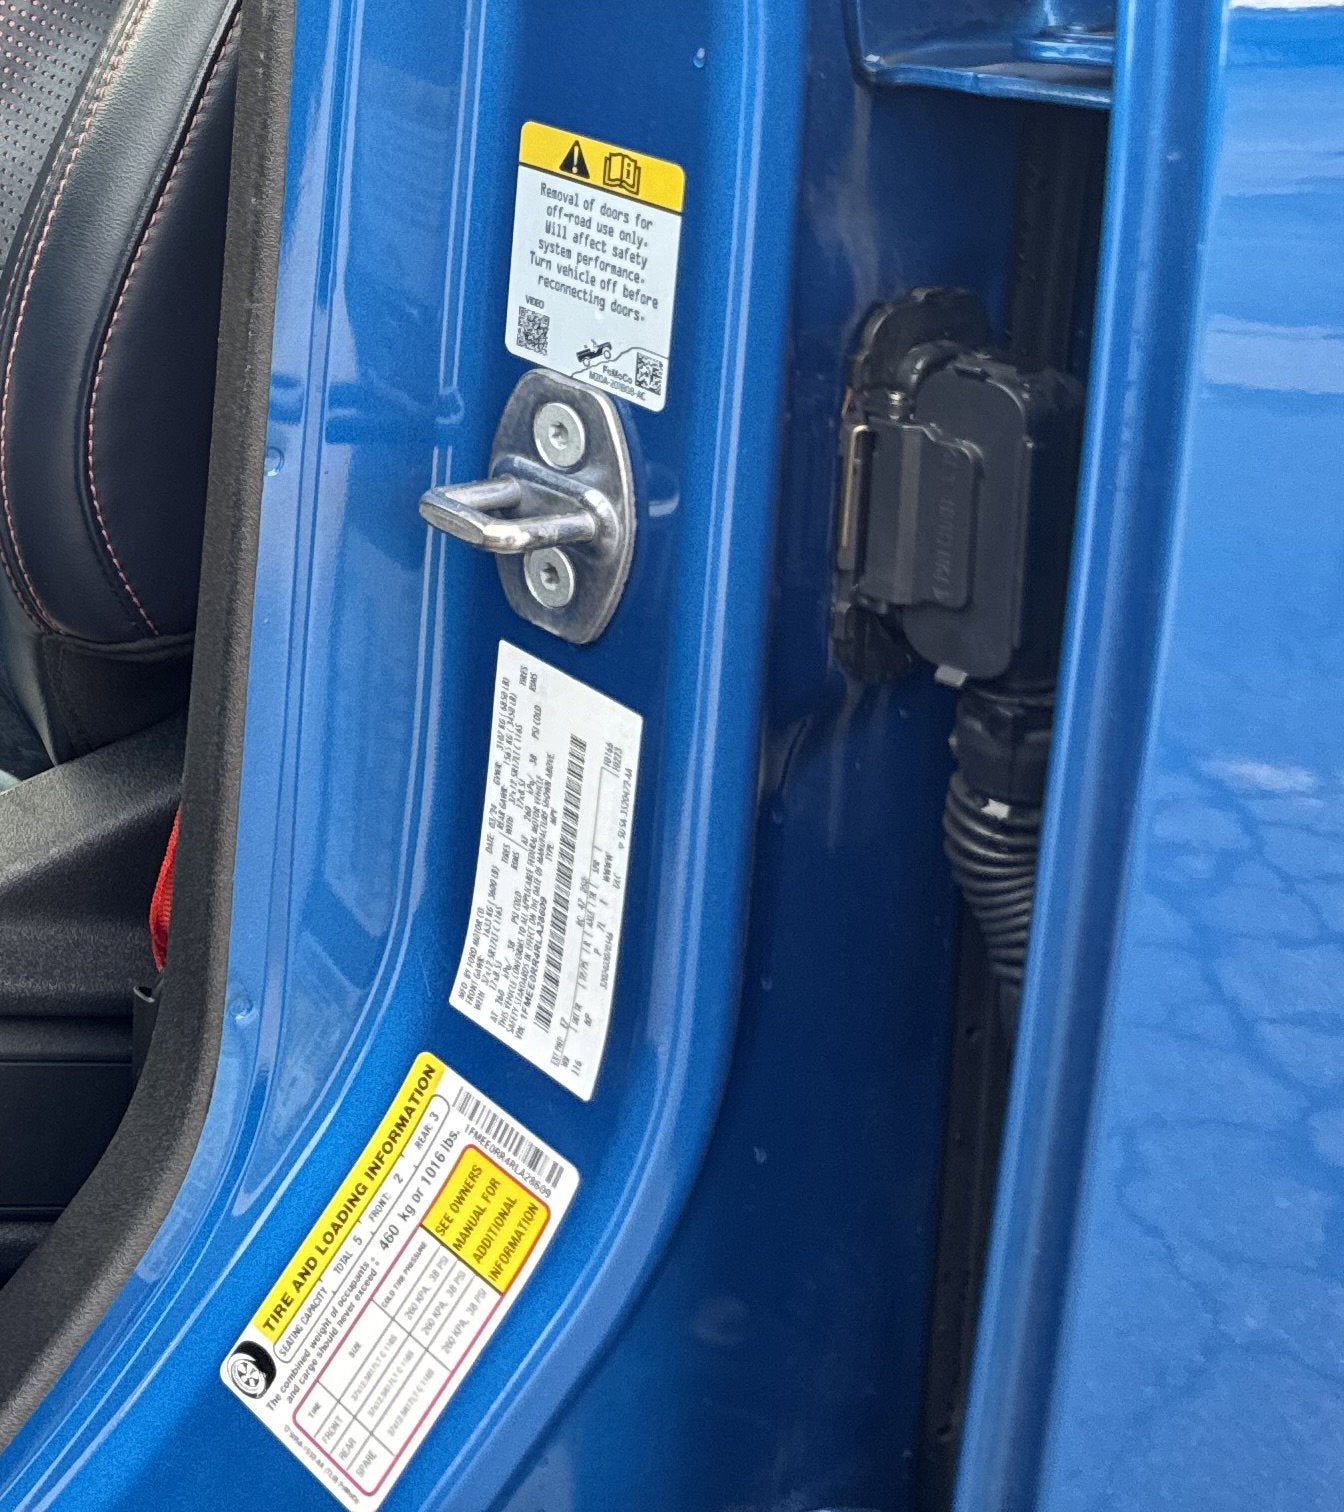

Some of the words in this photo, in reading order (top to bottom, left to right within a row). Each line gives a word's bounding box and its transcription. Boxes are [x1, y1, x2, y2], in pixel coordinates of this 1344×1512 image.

[540, 181, 579, 207] Removal
[583, 196, 594, 212] of
[600, 202, 629, 223] doors
[635, 213, 653, 232] for
[546, 202, 592, 230] off-road
[596, 220, 614, 237] use
[619, 227, 648, 251] only.
[529, 250, 551, 270] Turn
[556, 260, 596, 287] vehicle
[599, 276, 617, 294] off
[622, 284, 658, 309] before
[538, 236, 572, 263] system
[576, 250, 645, 289] performance.
[544, 220, 567, 240] Will
[572, 229, 607, 254] affect
[611, 243, 648, 270] safety
[537, 271, 605, 311] reconnecting
[610, 299, 645, 324] doors.
[262, 1289, 295, 1336] TIRE
[289, 1253, 319, 1294] AND
[314, 1178, 368, 1257] LOADING
[359, 1062, 441, 1182] INFORMATION
[377, 1222, 400, 1251] 460
[397, 1201, 416, 1223] kg
[411, 1186, 425, 1204] or
[419, 1150, 446, 1186] 1016
[439, 1125, 461, 1152] lbs.
[434, 1211, 454, 1237] SEE
[447, 1163, 484, 1214] OWNERS
[451, 1201, 487, 1251] MANUAL
[480, 1176, 501, 1203] FOR
[278, 1321, 304, 1358] SEATING
[299, 1284, 328, 1326] CAPACITY
[352, 1233, 363, 1246] 5
[392, 1172, 404, 1184] 2
[428, 1110, 439, 1122] 3
[403, 1240, 427, 1276] PRESSURE
[469, 1193, 519, 1264] ADDITIONAL
[485, 1201, 542, 1283] INFORMATION
[445, 1283, 458, 1298] 38
[453, 1269, 466, 1285] PSI
[465, 1300, 478, 1316] 38
[473, 1286, 487, 1303] PSI
[265, 1390, 281, 1412] The
[279, 1348, 311, 1395] combined
[308, 1316, 332, 1351] weight
[328, 1305, 339, 1318] of
[336, 1259, 370, 1309] occupants
[285, 1383, 300, 1404] and
[298, 1357, 319, 1387] cargo
[315, 1325, 338, 1359] should
[336, 1300, 355, 1327] never
[353, 1267, 377, 1302] exceed
[321, 1414, 343, 1445] FRONT
[428, 1268, 440, 1282] 38
[435, 1254, 449, 1270] PSI
